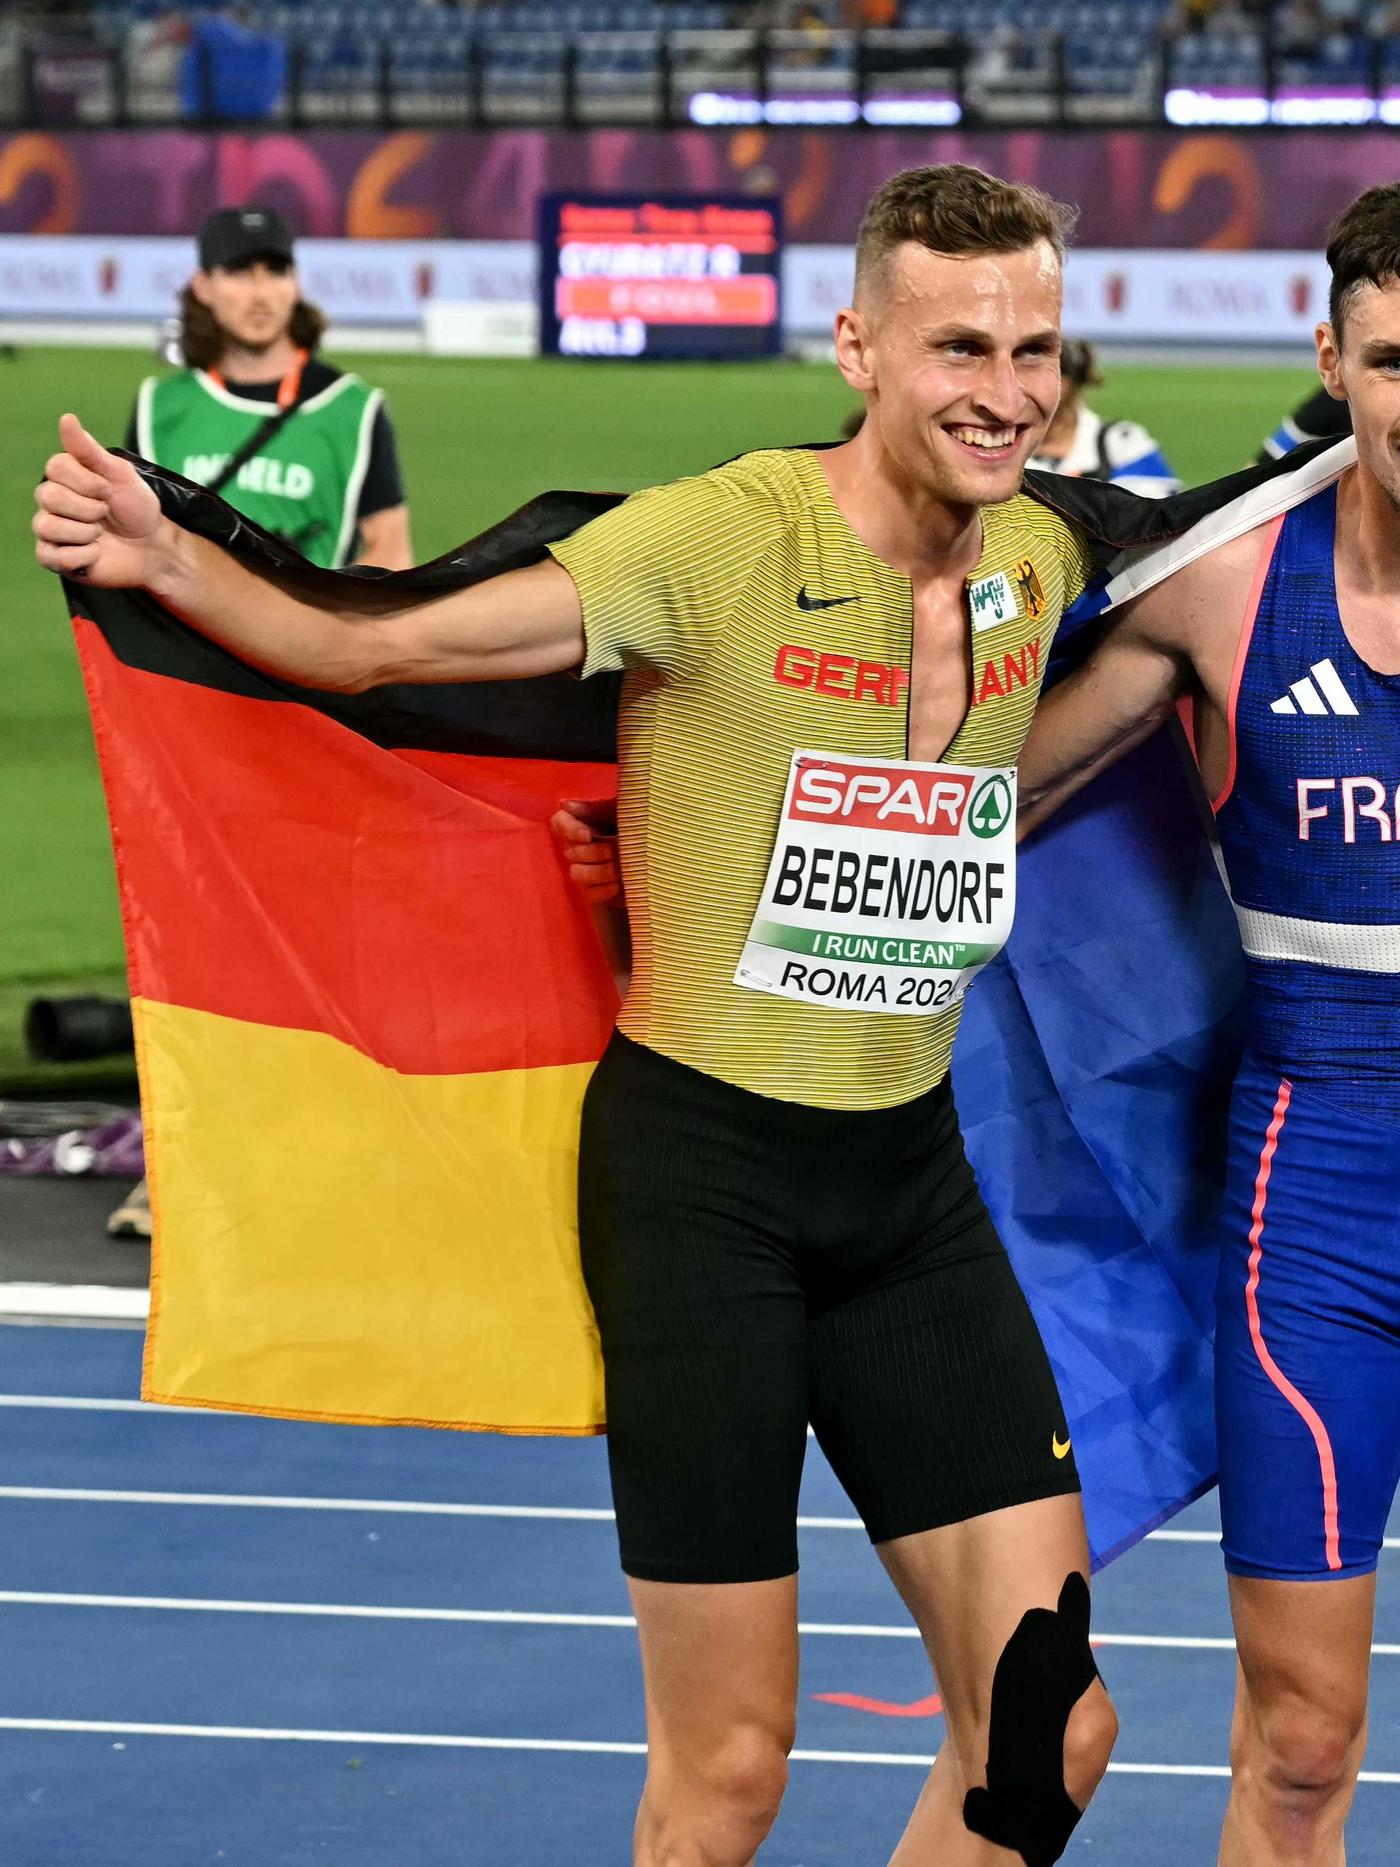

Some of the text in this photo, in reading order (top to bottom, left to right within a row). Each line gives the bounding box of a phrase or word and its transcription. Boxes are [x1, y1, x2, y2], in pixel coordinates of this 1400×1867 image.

[795, 769, 966, 827] SPAR
[771, 844, 1005, 924] BEBENDORF
[825, 935, 878, 960] RUN
[780, 961, 958, 1006] ROMA 202
